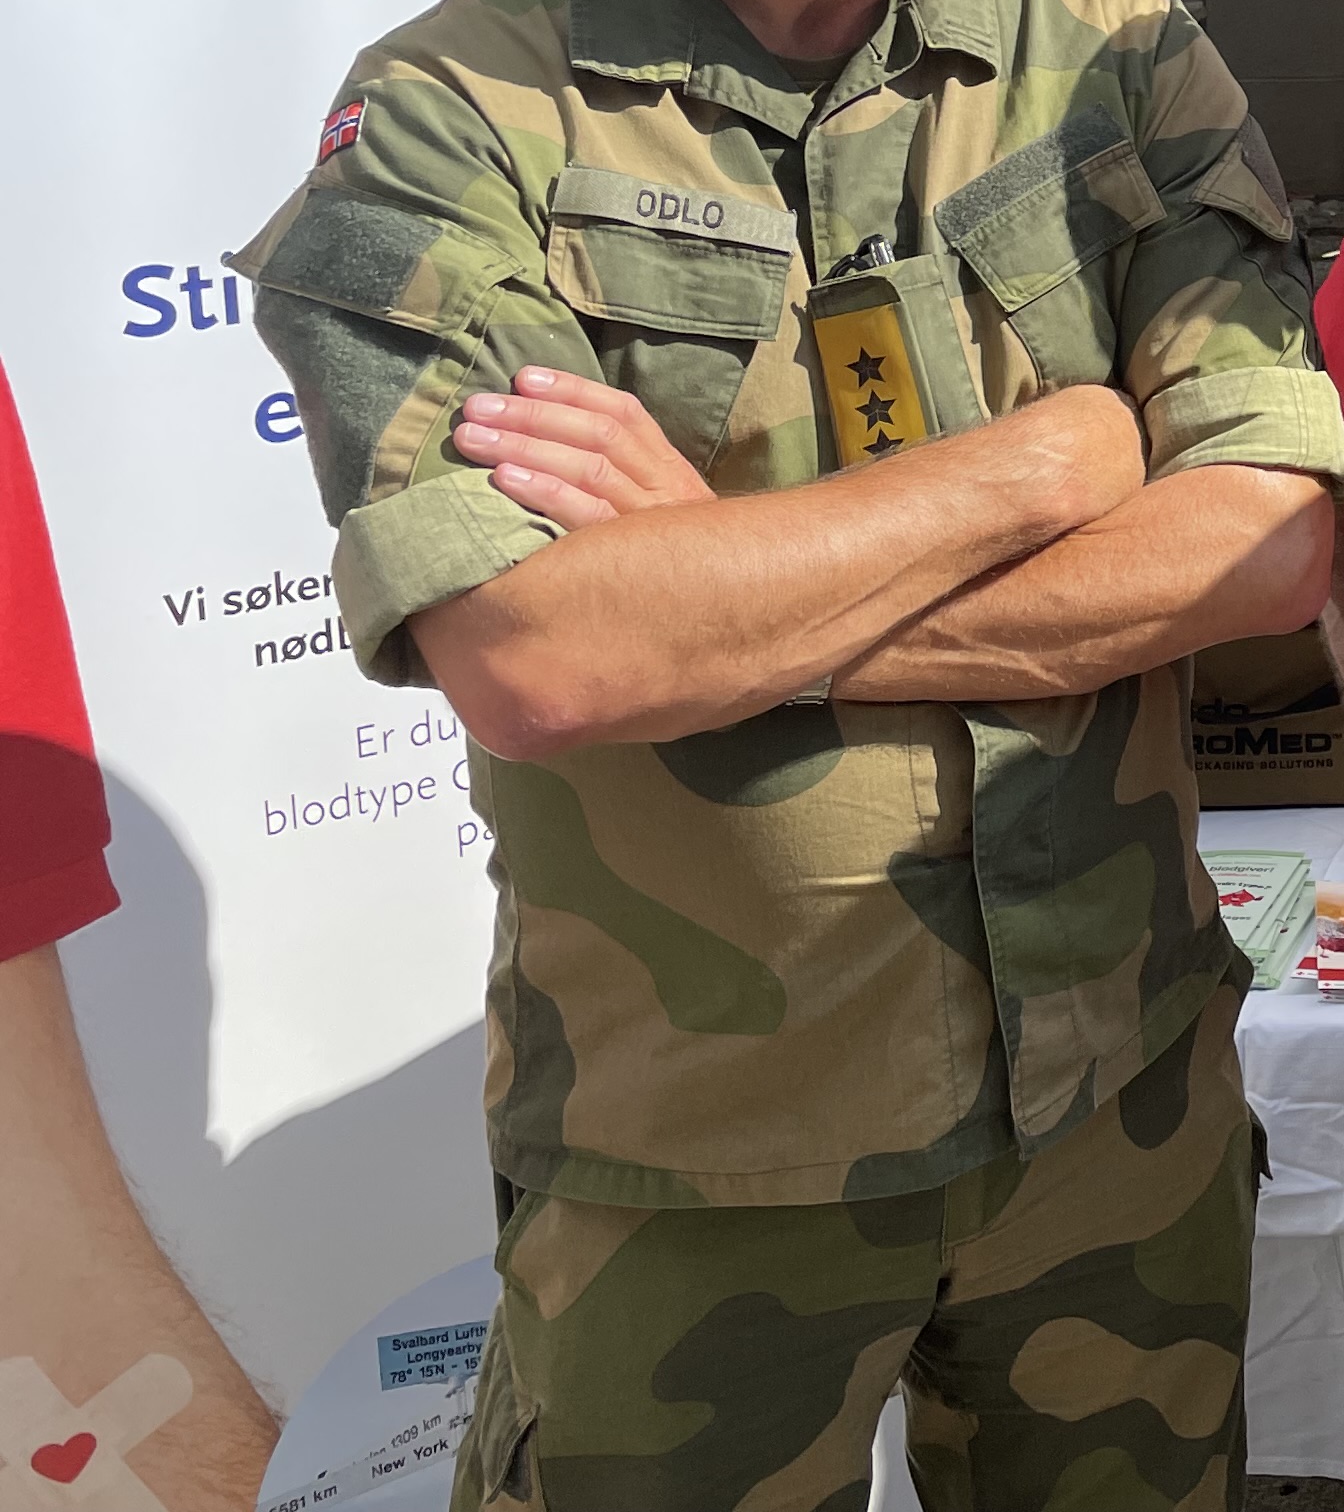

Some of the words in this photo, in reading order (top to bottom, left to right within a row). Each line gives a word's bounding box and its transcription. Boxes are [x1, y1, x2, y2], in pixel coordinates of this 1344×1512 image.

[636, 189, 725, 229] ODLO
[163, 585, 207, 626] Vi
[357, 724, 395, 758] Er
[410, 709, 458, 746] du
[1260, 758, 1334, 770] SOLUTIONS
[264, 776, 437, 835] blodtype
[392, 1331, 449, 1351] Svalbard
[407, 1343, 482, 1364] Longyearby
[390, 1369, 412, 1384] 78°
[419, 1364, 445, 1378] 15N
[422, 1414, 442, 1433] km
[371, 1455, 406, 1479] New
[413, 1439, 450, 1461] York
[313, 1484, 338, 1502] km
